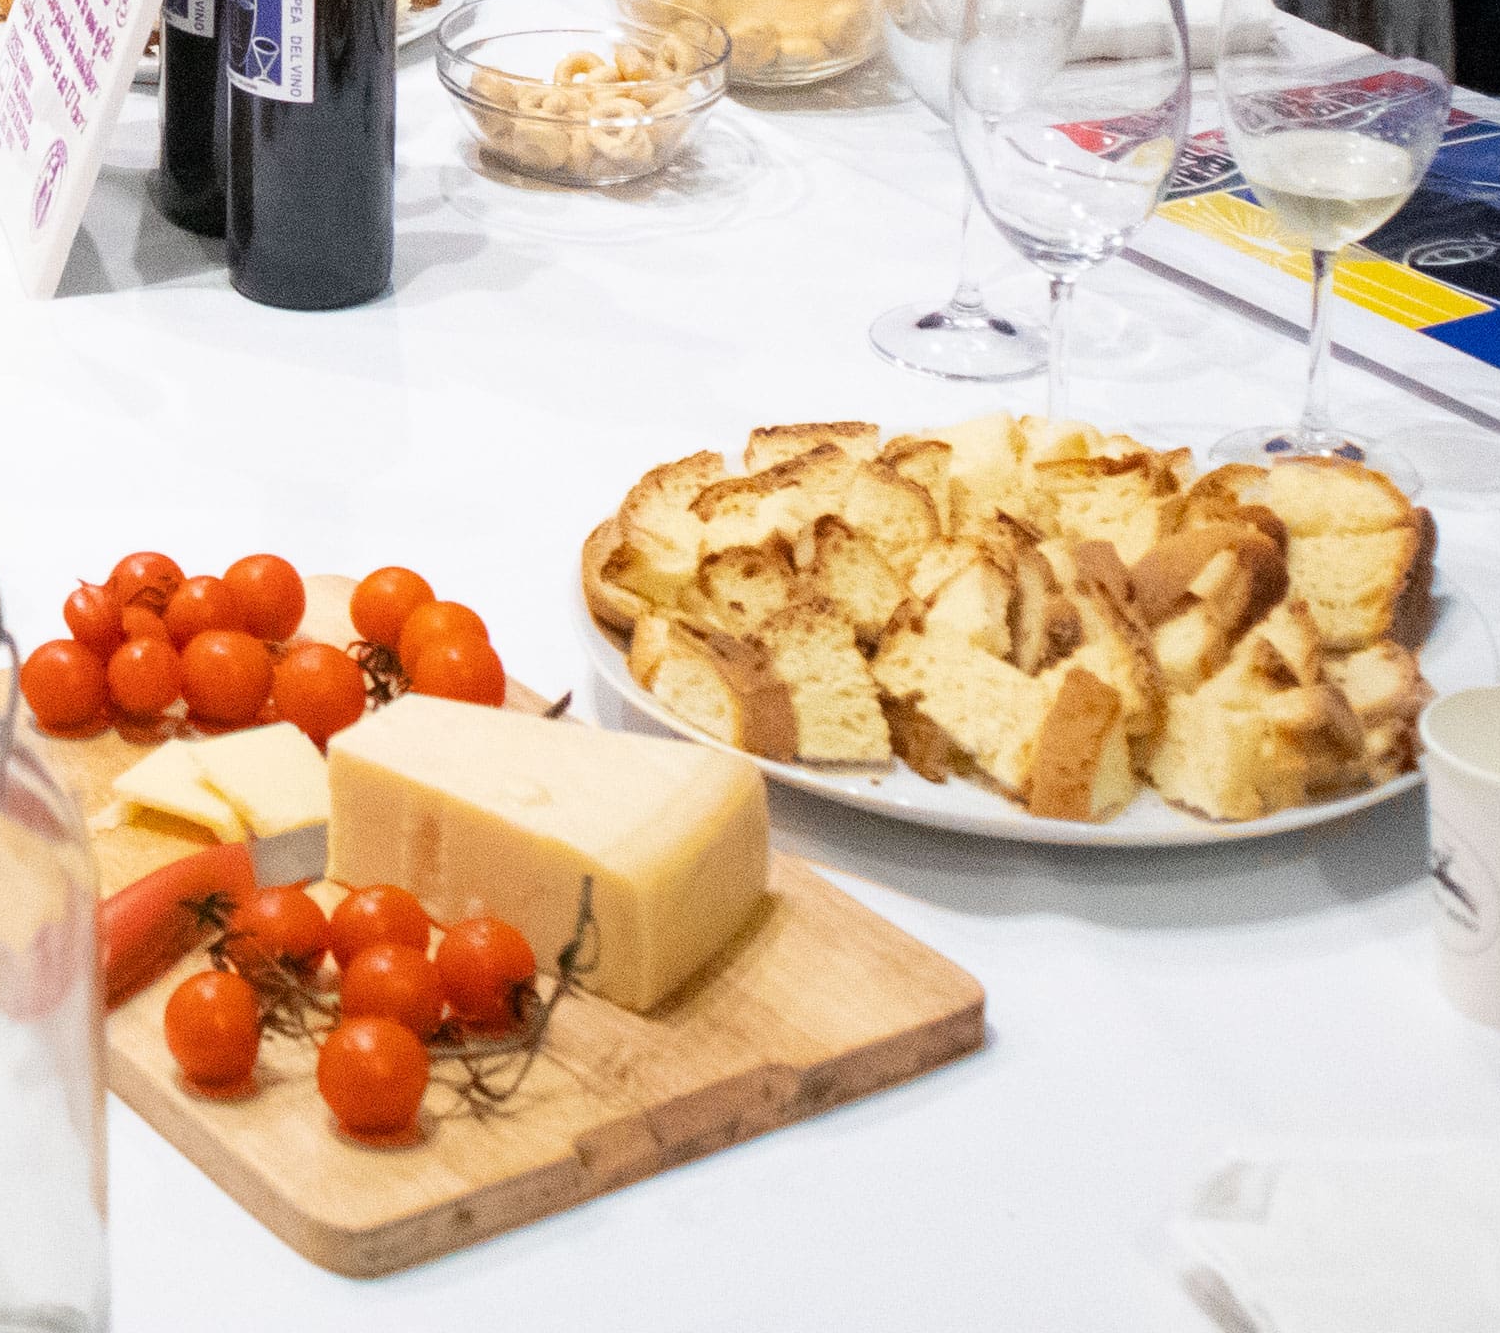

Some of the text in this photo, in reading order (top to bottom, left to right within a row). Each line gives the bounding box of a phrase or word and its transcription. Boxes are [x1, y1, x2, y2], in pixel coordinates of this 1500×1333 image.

[193, 0, 206, 31] VINO
[289, 37, 303, 62] DEL
[289, 64, 303, 98] VINO
